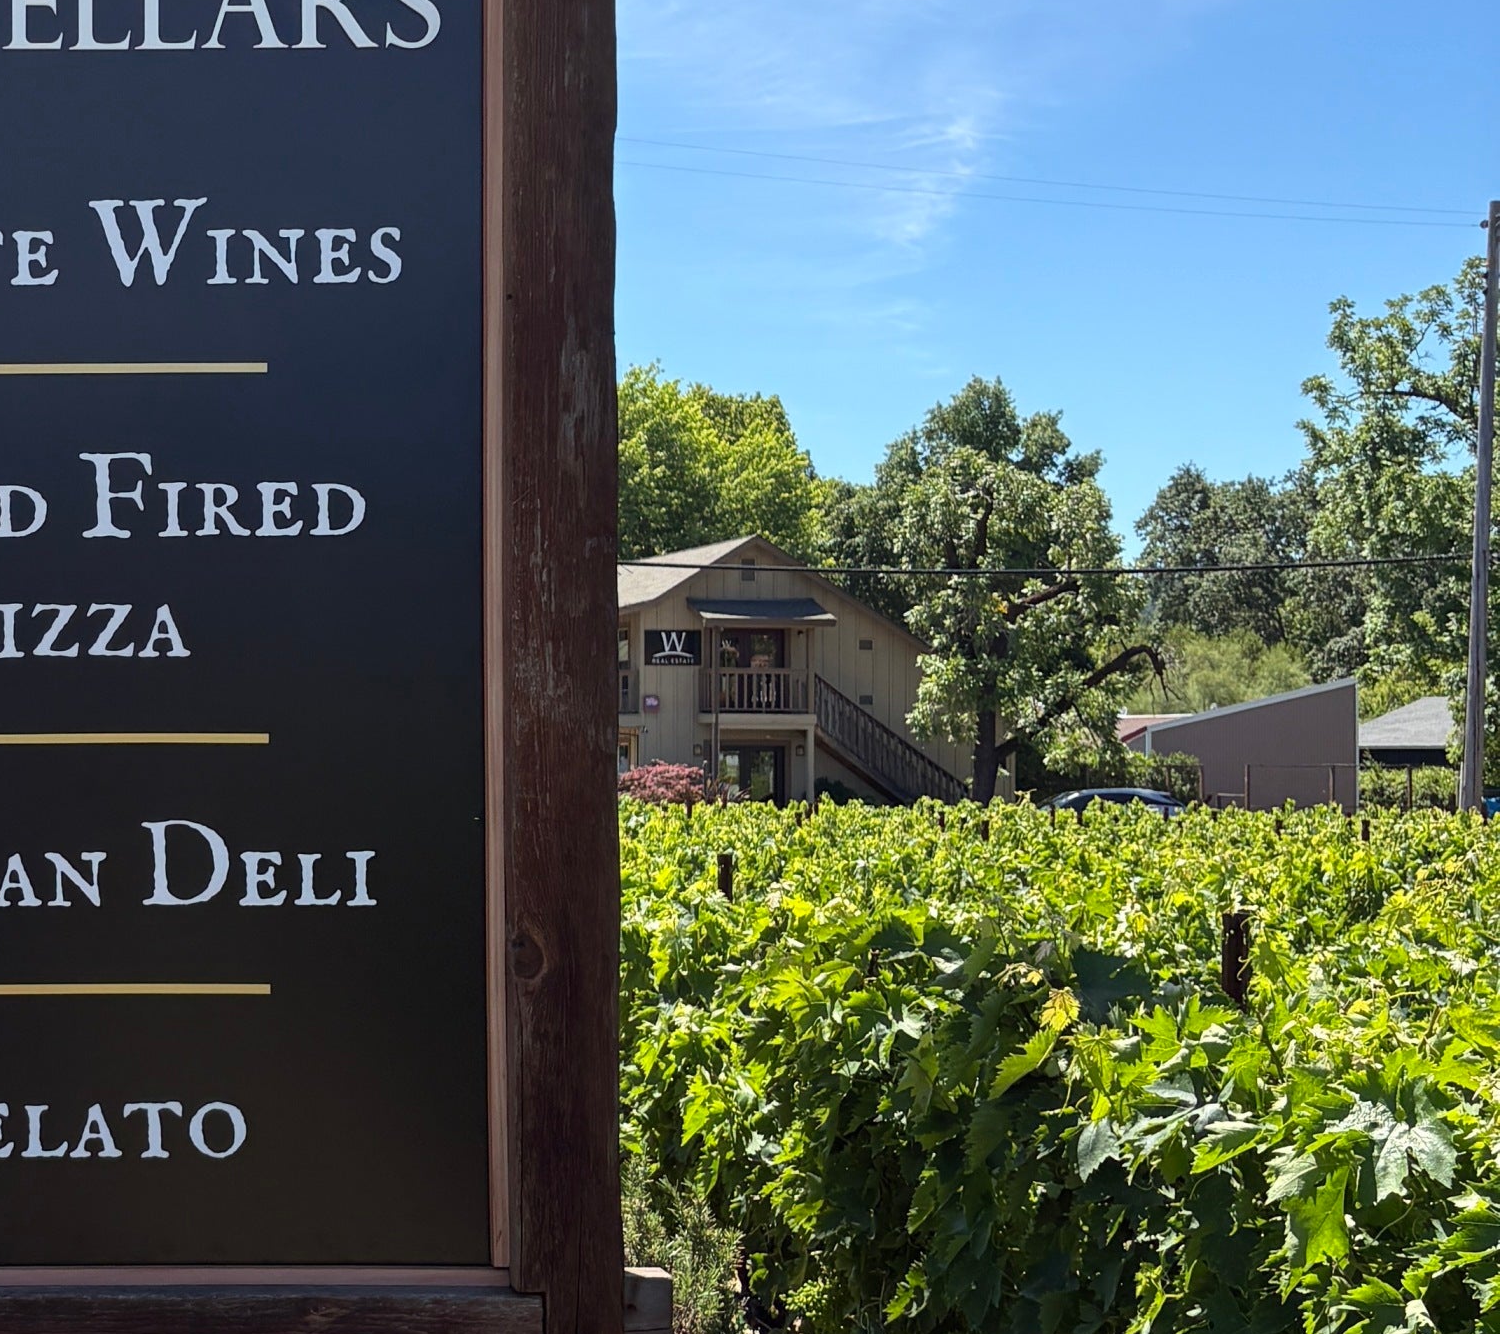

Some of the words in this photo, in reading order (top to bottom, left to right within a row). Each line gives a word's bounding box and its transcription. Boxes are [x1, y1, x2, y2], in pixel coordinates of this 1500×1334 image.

[89, 198, 402, 287] WINES
[80, 452, 366, 539] FIRED
[142, 820, 377, 907] DELI
